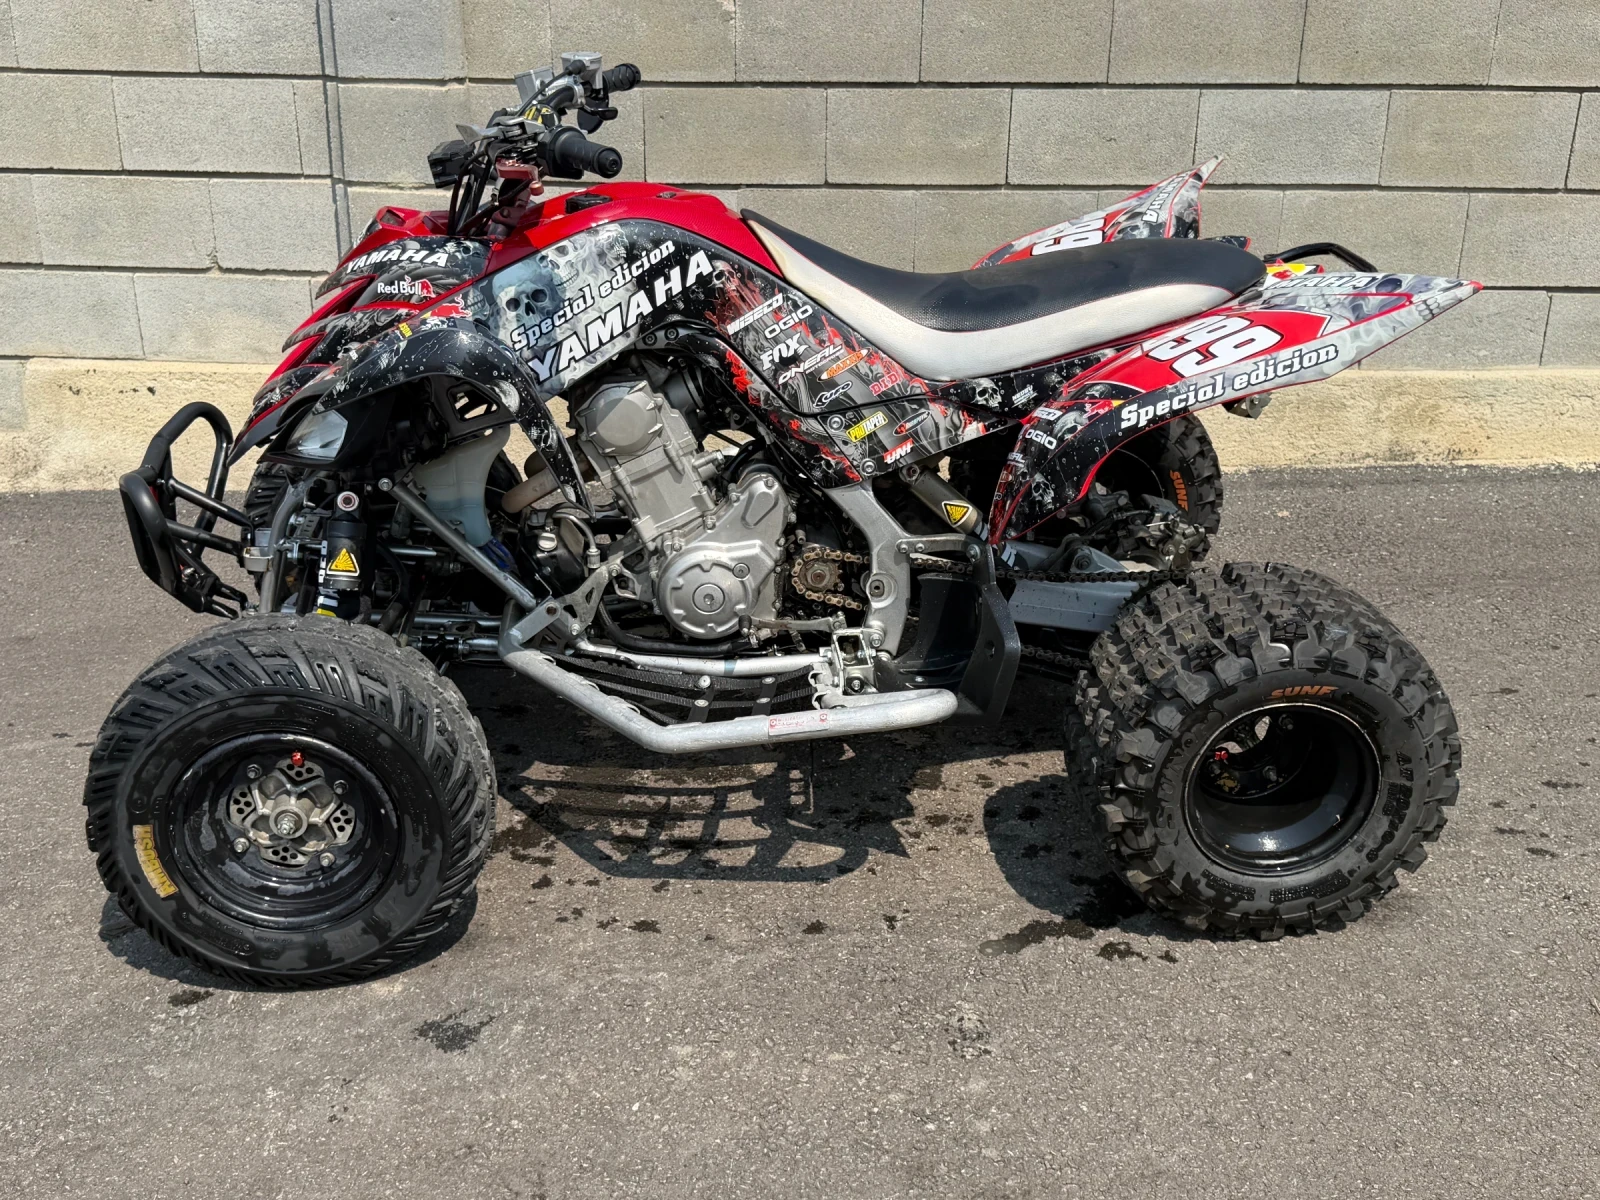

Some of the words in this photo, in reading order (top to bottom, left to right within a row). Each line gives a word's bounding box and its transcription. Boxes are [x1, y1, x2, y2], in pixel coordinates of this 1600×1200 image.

[346, 248, 451, 275] YAMAHA
[376, 279, 398, 294] Red
[399, 280, 422, 295] Bull
[510, 284, 596, 351] Special
[599, 240, 676, 298] edicion
[527, 249, 714, 386] YAMAHA
[764, 304, 814, 339] OGIO
[825, 349, 865, 380] MAXXIS
[821, 381, 853, 404] UFO
[1119, 370, 1227, 432] Special
[1232, 343, 1340, 392] edicion
[1025, 428, 1058, 450] OGIO
[1266, 685, 1339, 699] SUNF
